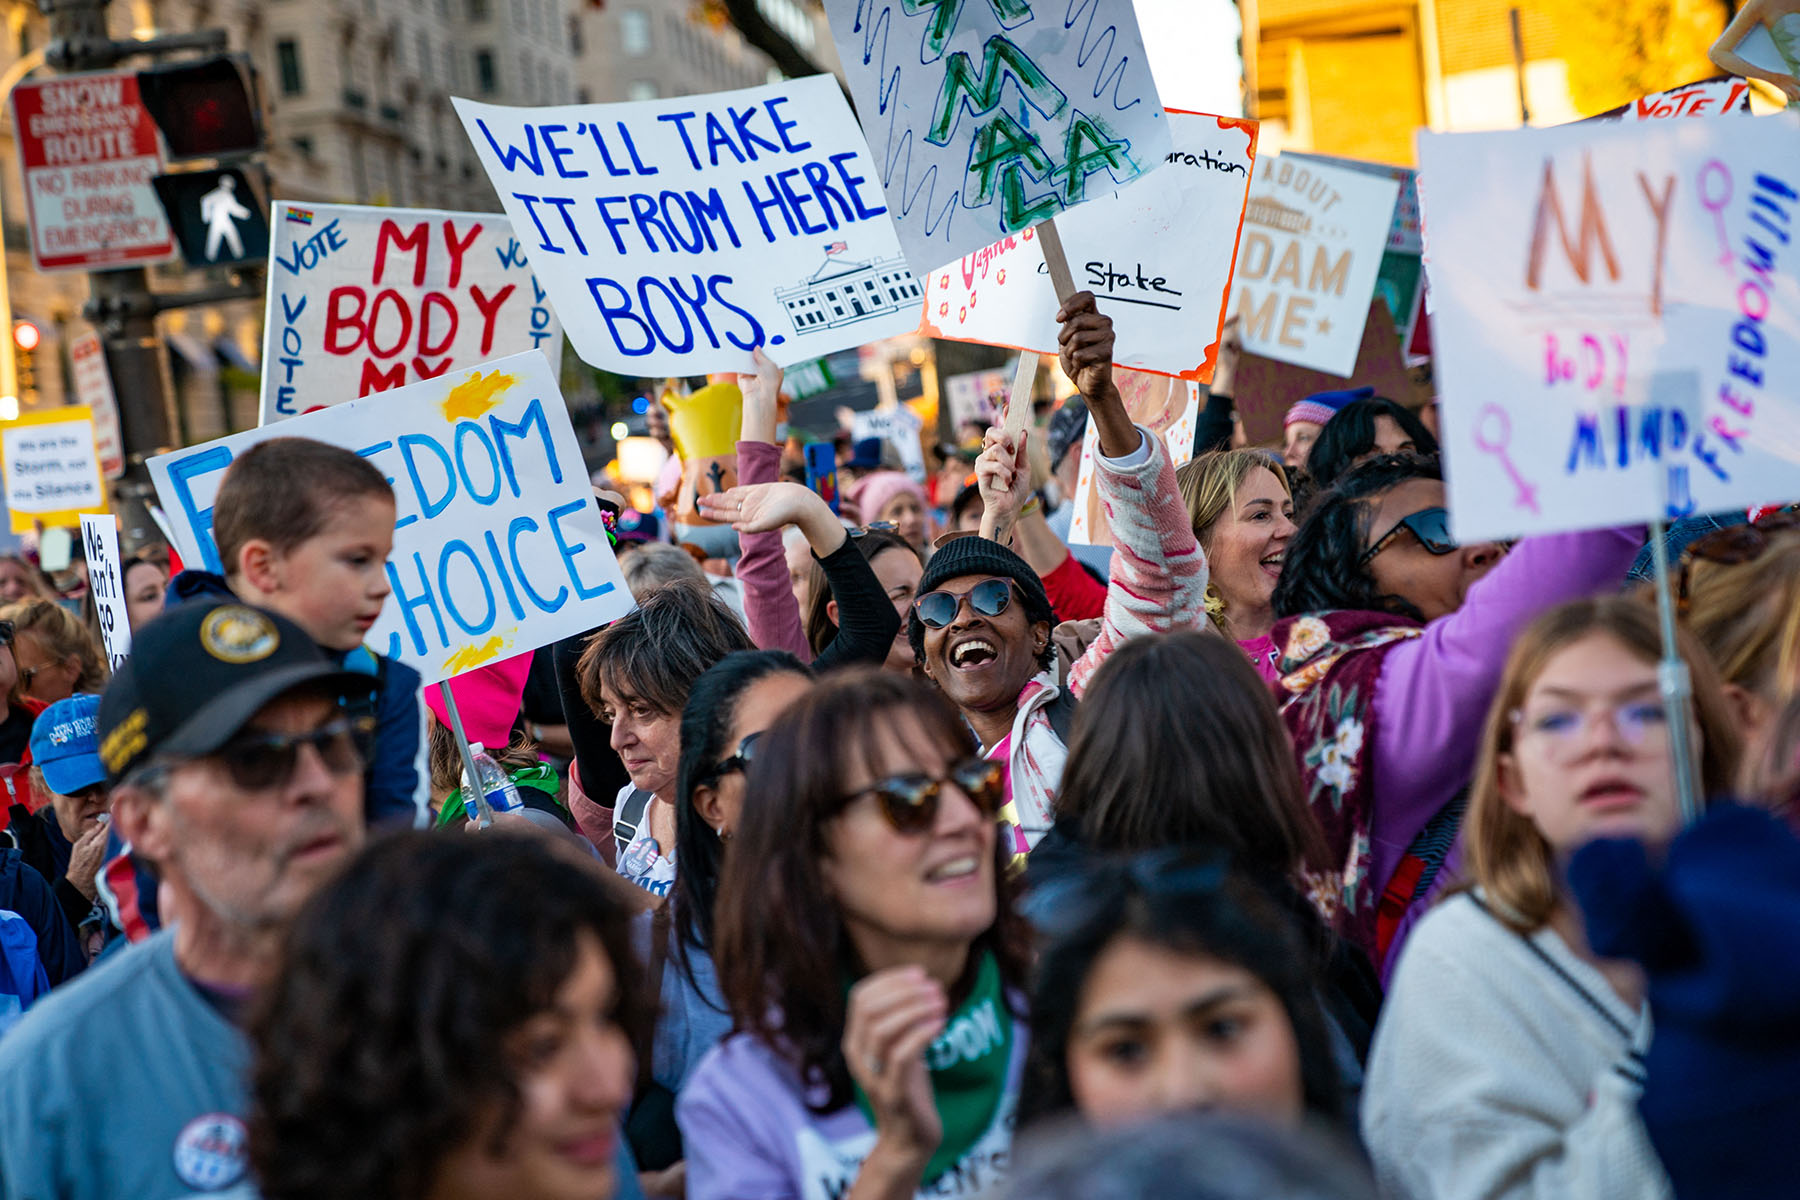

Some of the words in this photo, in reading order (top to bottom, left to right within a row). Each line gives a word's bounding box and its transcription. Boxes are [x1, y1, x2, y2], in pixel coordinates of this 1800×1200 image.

[29, 105, 140, 137] EMERGENCY
[40, 80, 124, 114] SNOW
[43, 131, 135, 166] ROUTE
[475, 118, 658, 179] WE'LL
[657, 96, 811, 171] TAKE
[36, 172, 66, 196] NO
[71, 165, 152, 189] PARKING
[63, 194, 134, 219] DURING
[513, 192, 589, 256] IT
[596, 187, 742, 255] FROM
[742, 152, 887, 243] HERE
[1262, 159, 1343, 213] ABOUT
[45, 219, 158, 246] EMERGENCY
[276, 218, 348, 276] VOTE
[372, 218, 484, 289] MY
[1525, 148, 1676, 318] MY
[1085, 262, 1182, 296] State
[323, 285, 517, 359] BODY
[585, 273, 786, 356] BOYS.
[276, 293, 307, 415] VOTE
[83, 520, 104, 562] We
[386, 499, 616, 661] HOICE
[99, 602, 115, 643] go
